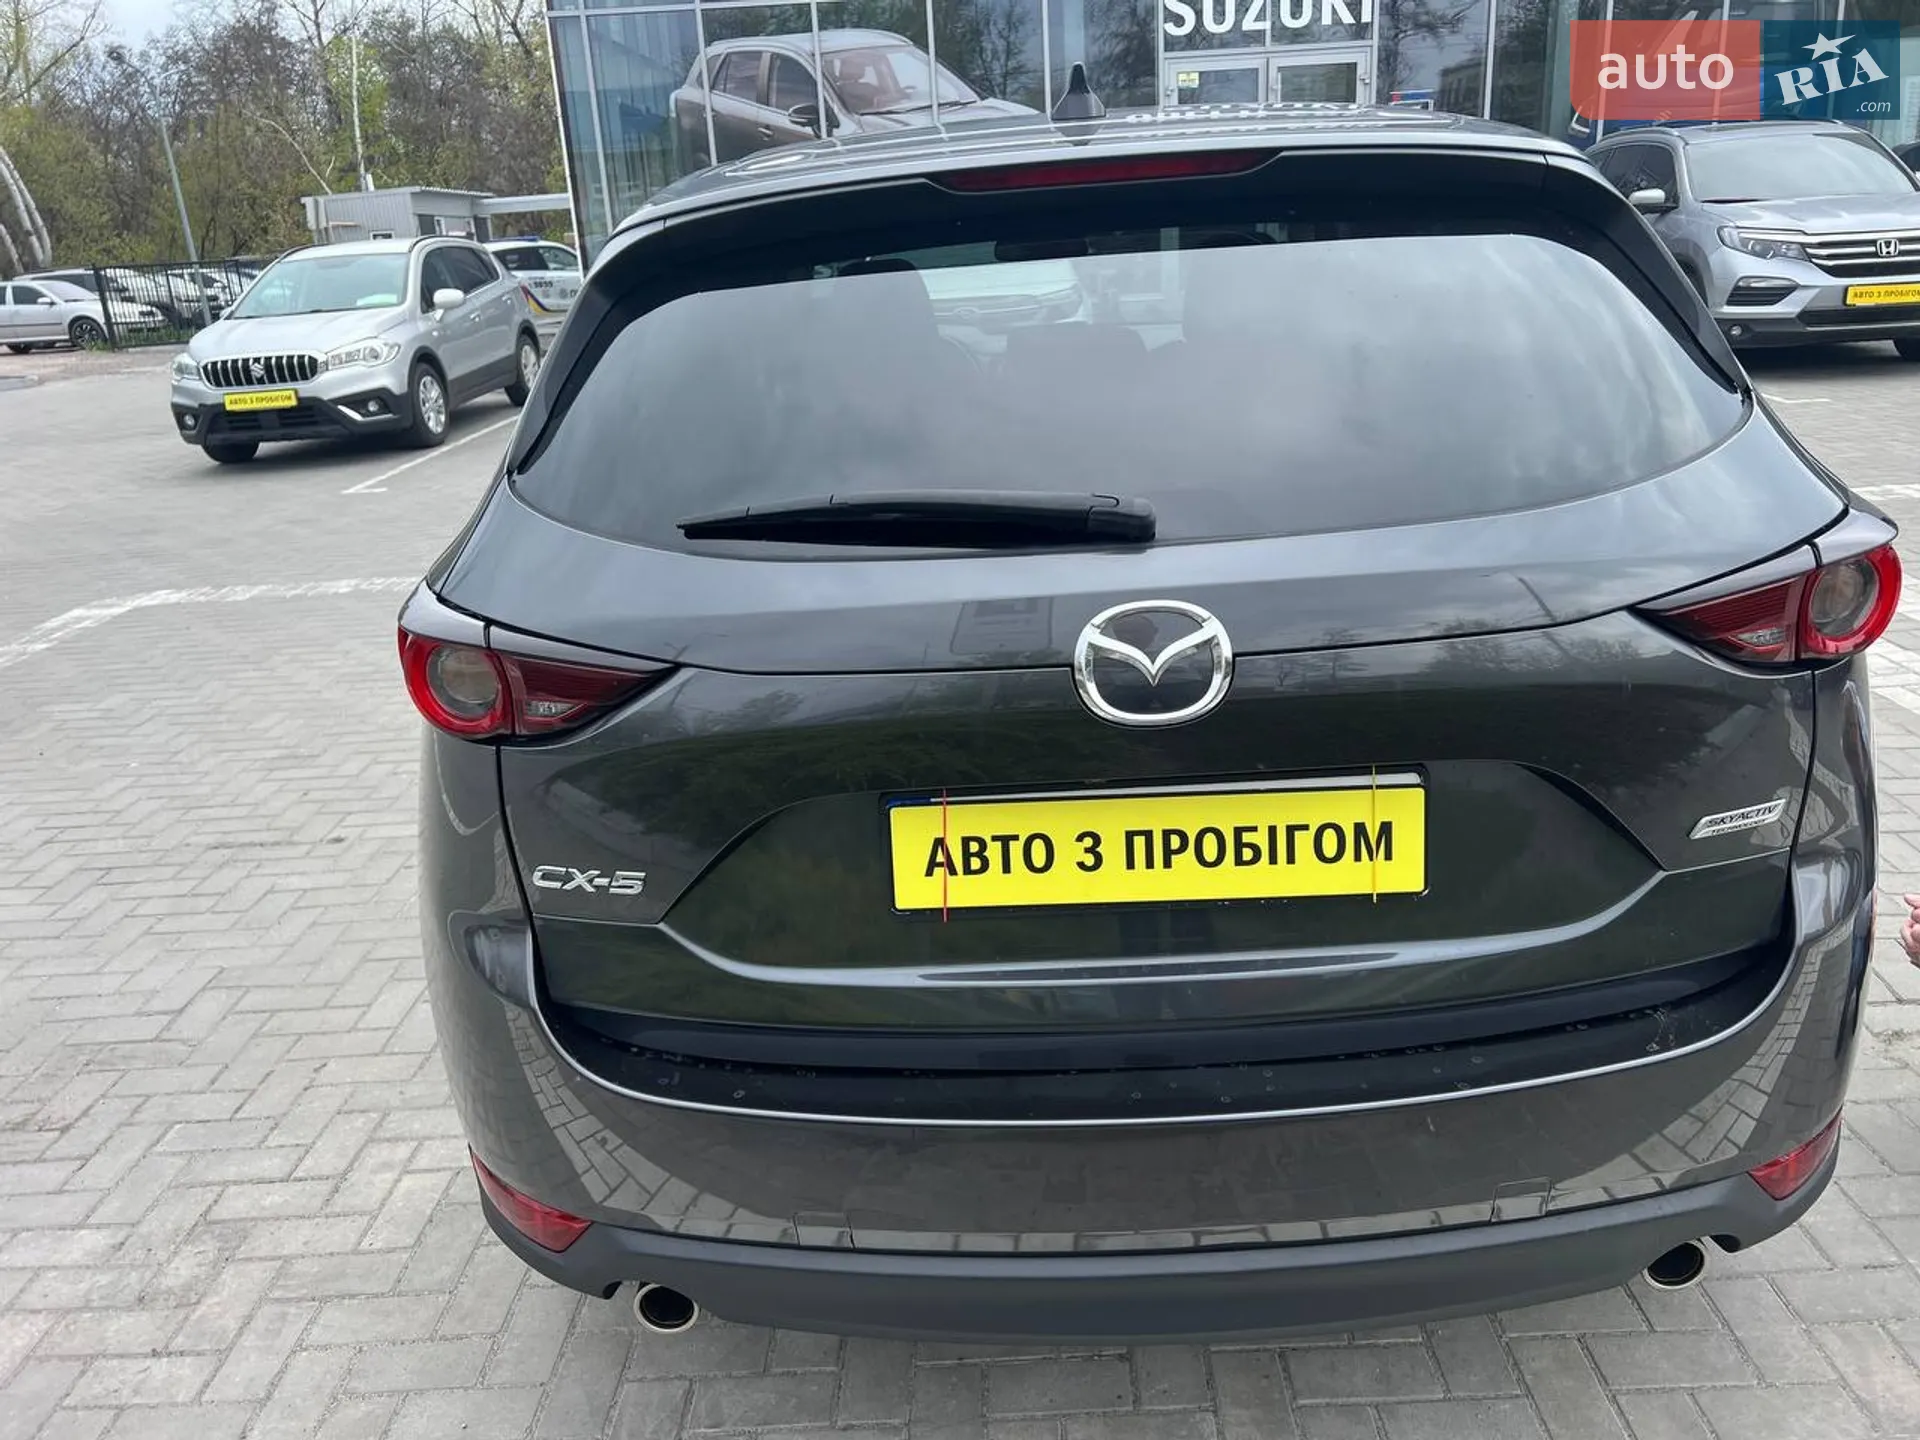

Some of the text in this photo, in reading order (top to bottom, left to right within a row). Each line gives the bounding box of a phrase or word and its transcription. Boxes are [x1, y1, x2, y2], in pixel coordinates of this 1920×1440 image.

[1707, 804, 1778, 826] SKYACTIV
[924, 820, 1394, 878] АВТО З ПРОБІГОМ
[532, 865, 647, 895] CX-5
